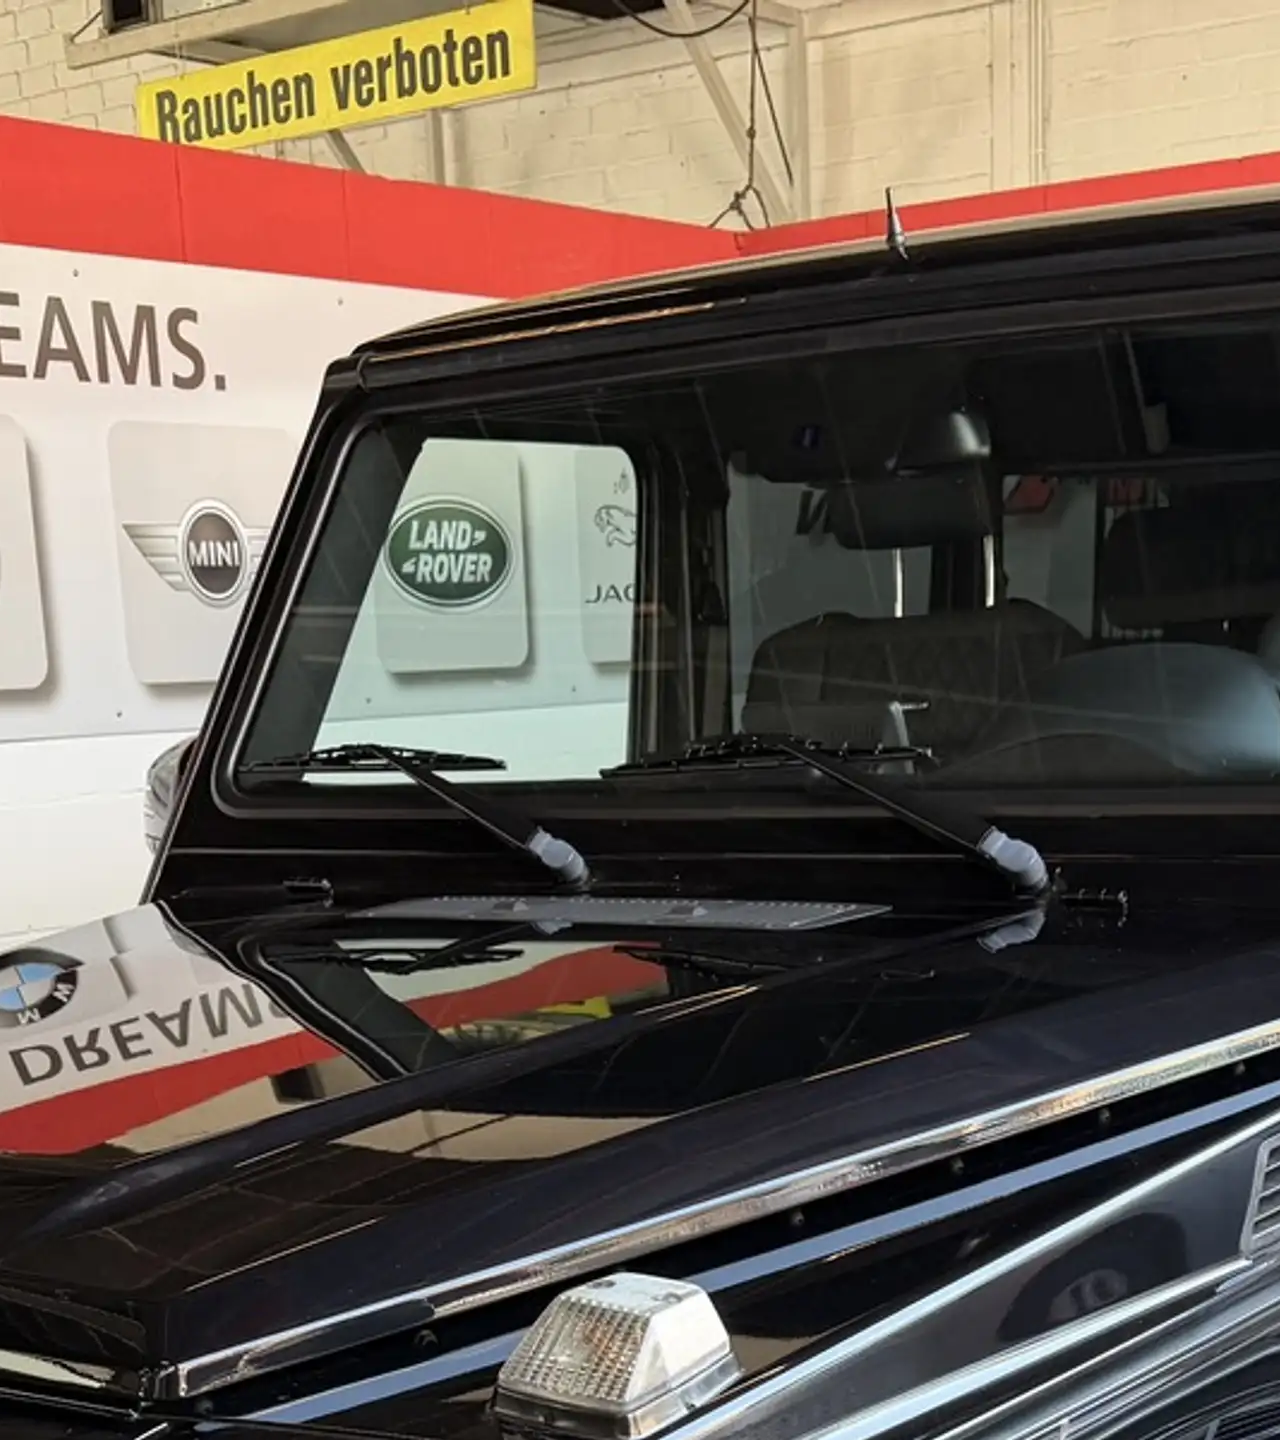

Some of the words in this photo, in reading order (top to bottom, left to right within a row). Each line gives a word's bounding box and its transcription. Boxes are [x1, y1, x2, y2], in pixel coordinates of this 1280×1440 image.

[155, 70, 316, 144] Rauchen
[329, 28, 512, 111] verboten
[408, 519, 473, 551] LAND
[188, 539, 241, 569] MINI
[415, 551, 493, 584] ROVER
